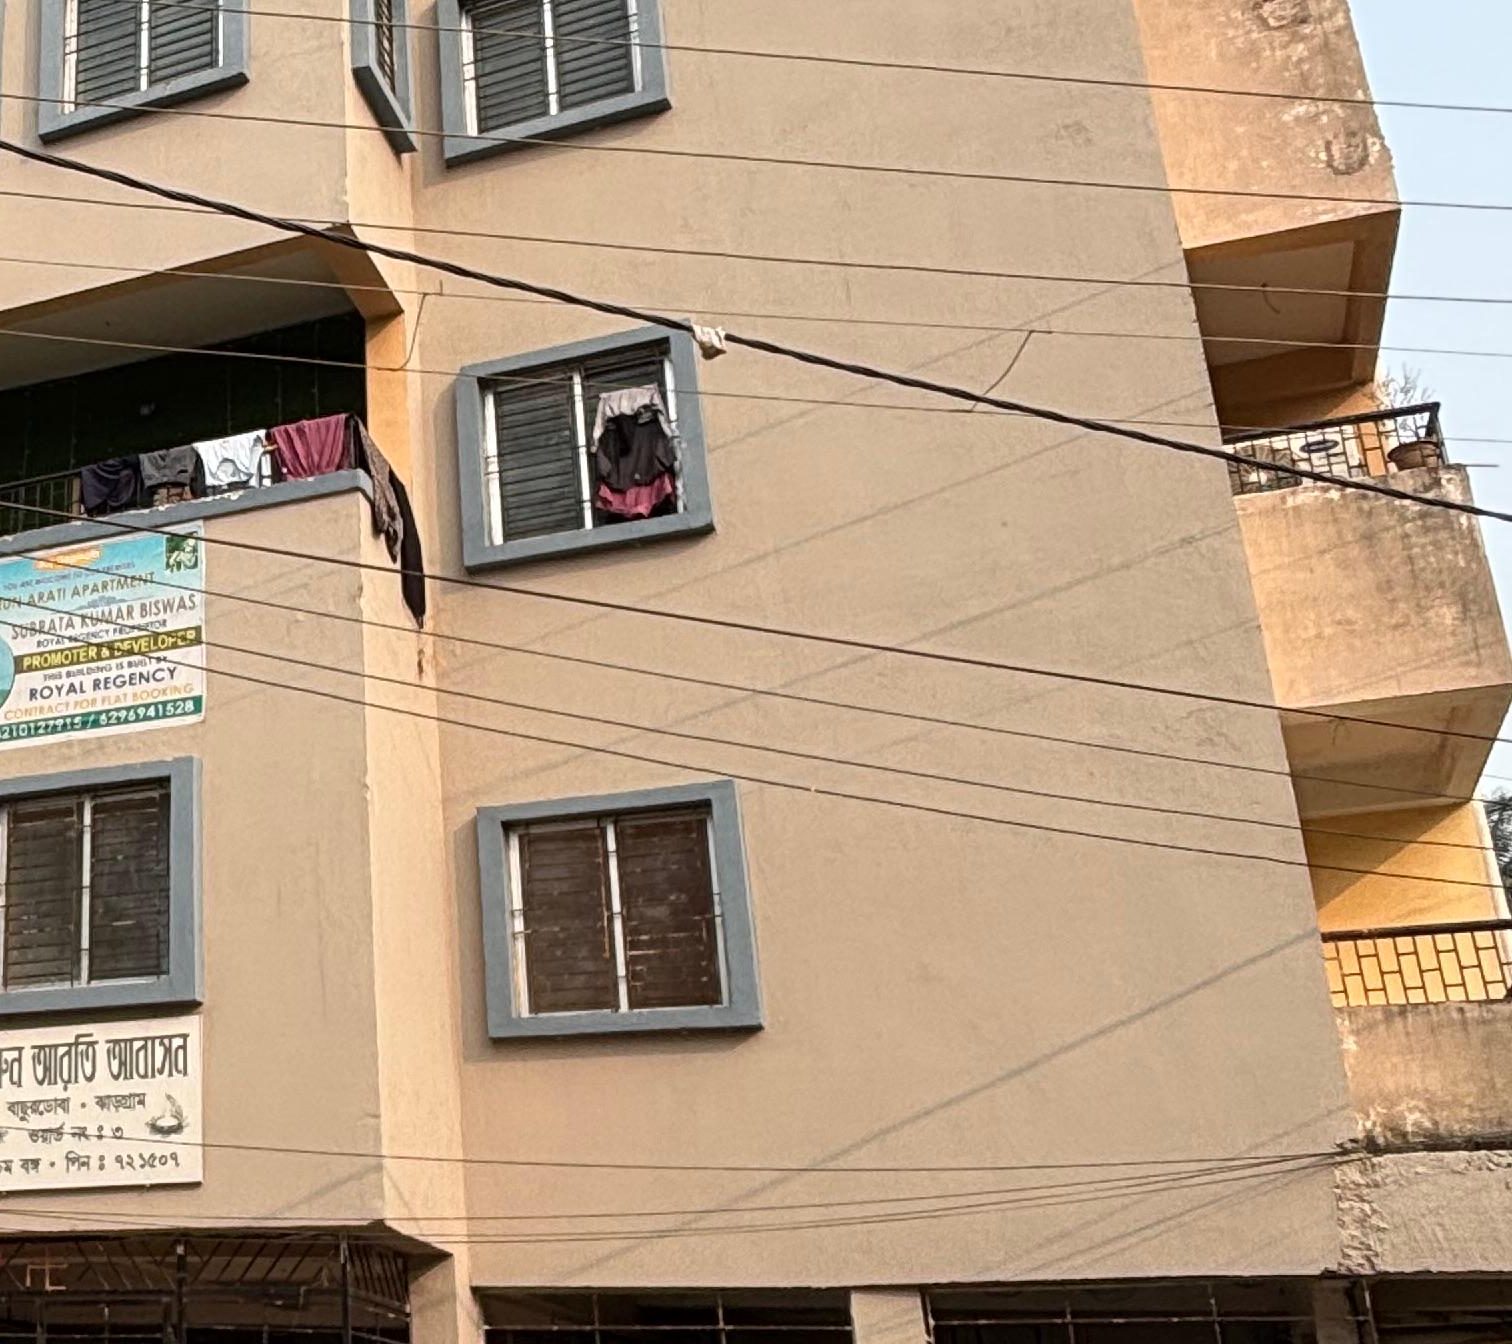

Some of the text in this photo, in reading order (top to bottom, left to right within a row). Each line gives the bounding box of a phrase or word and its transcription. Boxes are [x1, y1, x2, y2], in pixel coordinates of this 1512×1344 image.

[27, 588, 65, 605] ARATI
[70, 572, 154, 598] APARTMENT
[11, 593, 196, 640] SUBRATA KUMAR BISWAS
[22, 630, 194, 671] PROMOTER & DEVELOPER
[36, 637, 65, 648] ROYAL
[29, 666, 177, 702] ROYAL REGENCY
[43, 672, 62, 682] THIS
[65, 664, 112, 678] BUILDING
[116, 662, 123, 670] IS
[127, 658, 153, 669] BUILT
[4, 683, 193, 721] CONTRACT FOR FLAT BOOKING
[99, 699, 194, 725] 6296941528
[31, 1033, 99, 1092] আরতি
[105, 1033, 189, 1083] আবাসন
[65, 1151, 90, 1173] পিন
[114, 1151, 180, 1171] ৭২১৫০৭
